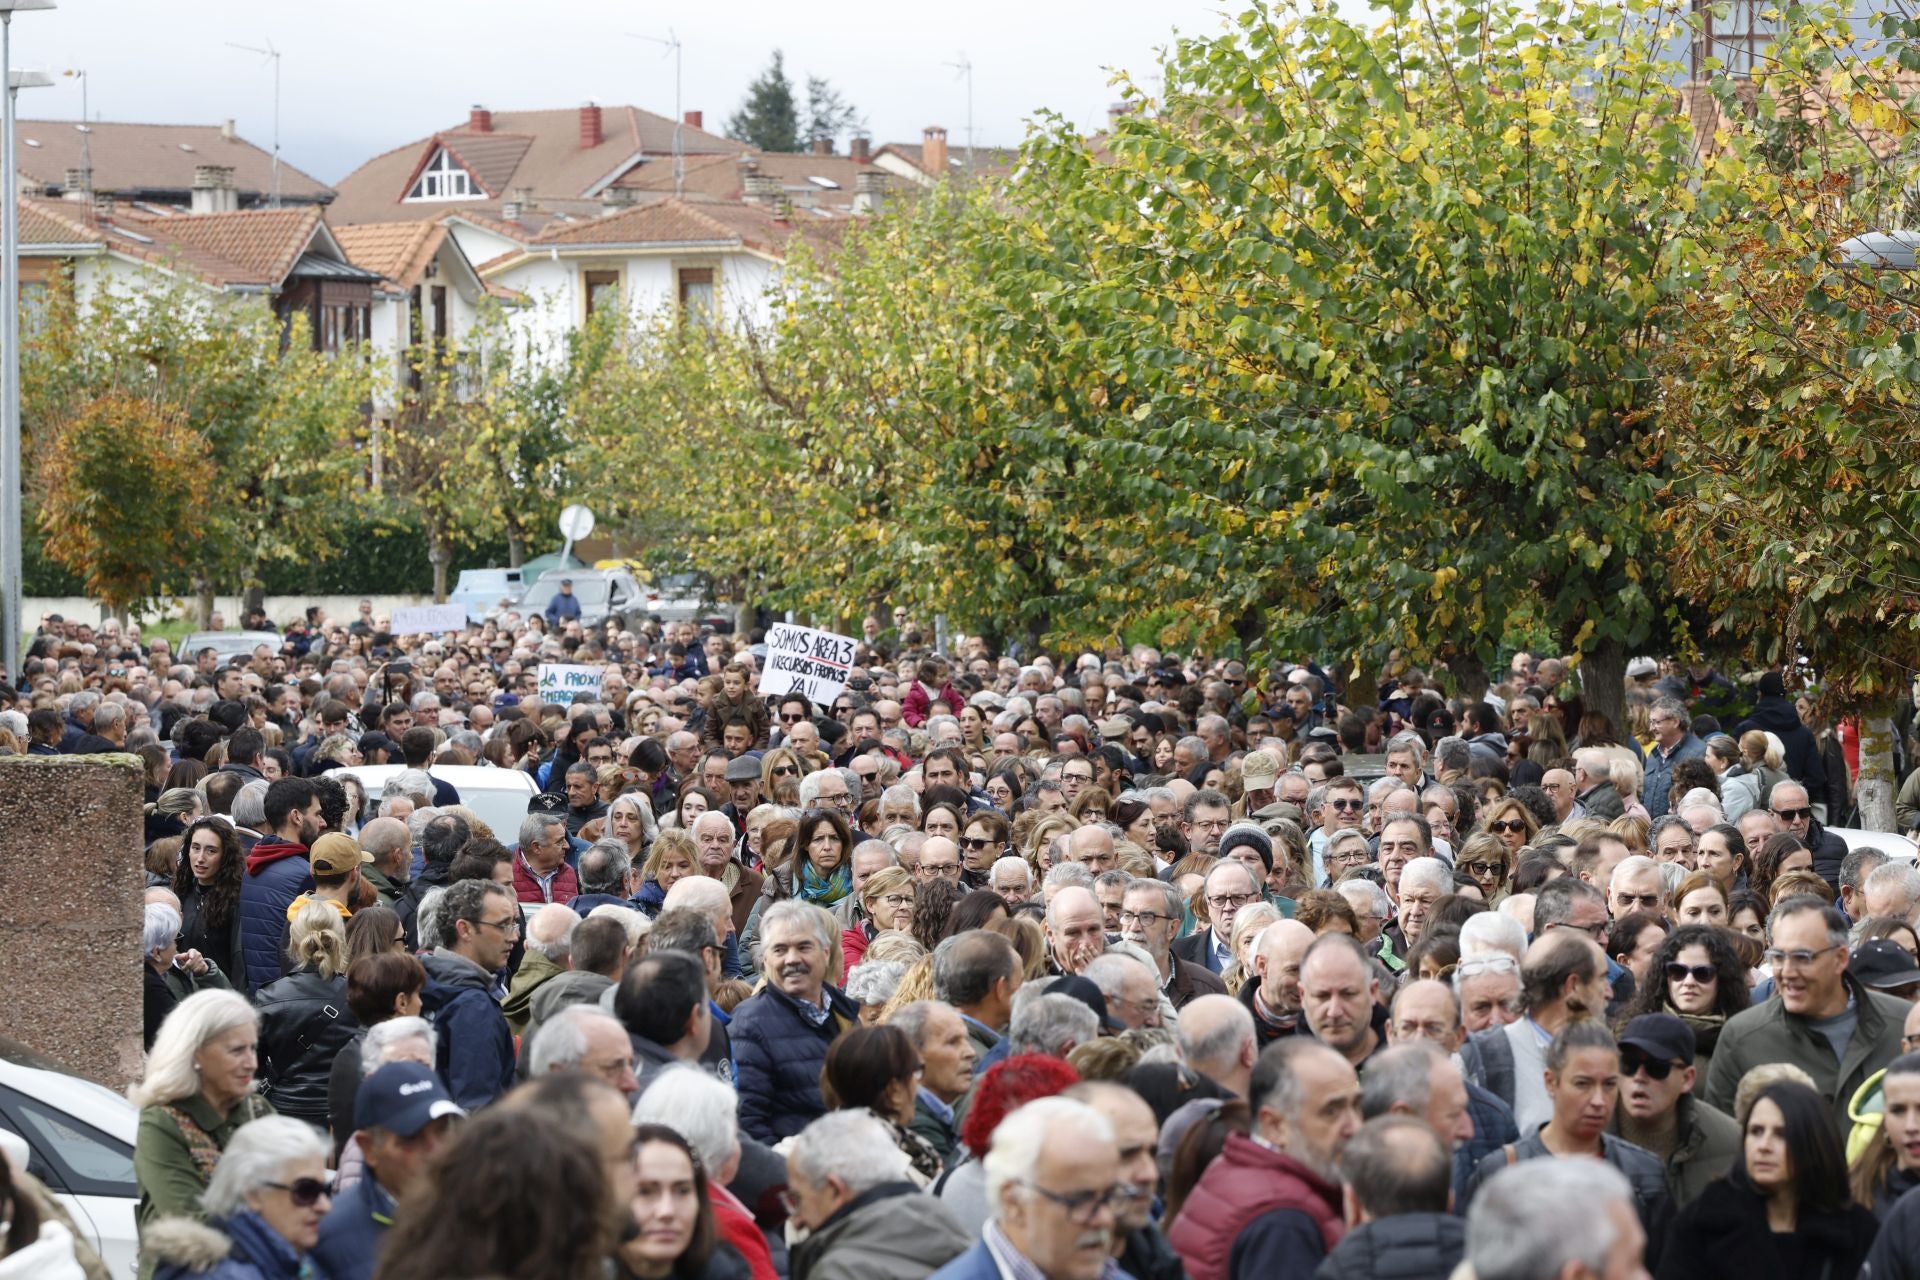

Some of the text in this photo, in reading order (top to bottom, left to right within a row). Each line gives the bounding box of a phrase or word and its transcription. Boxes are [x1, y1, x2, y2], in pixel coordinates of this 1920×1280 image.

[771, 628, 810, 654] SOMOS
[839, 641, 854, 665] 3
[540, 665, 557, 687] LA
[814, 664, 848, 683] PROPIOS
